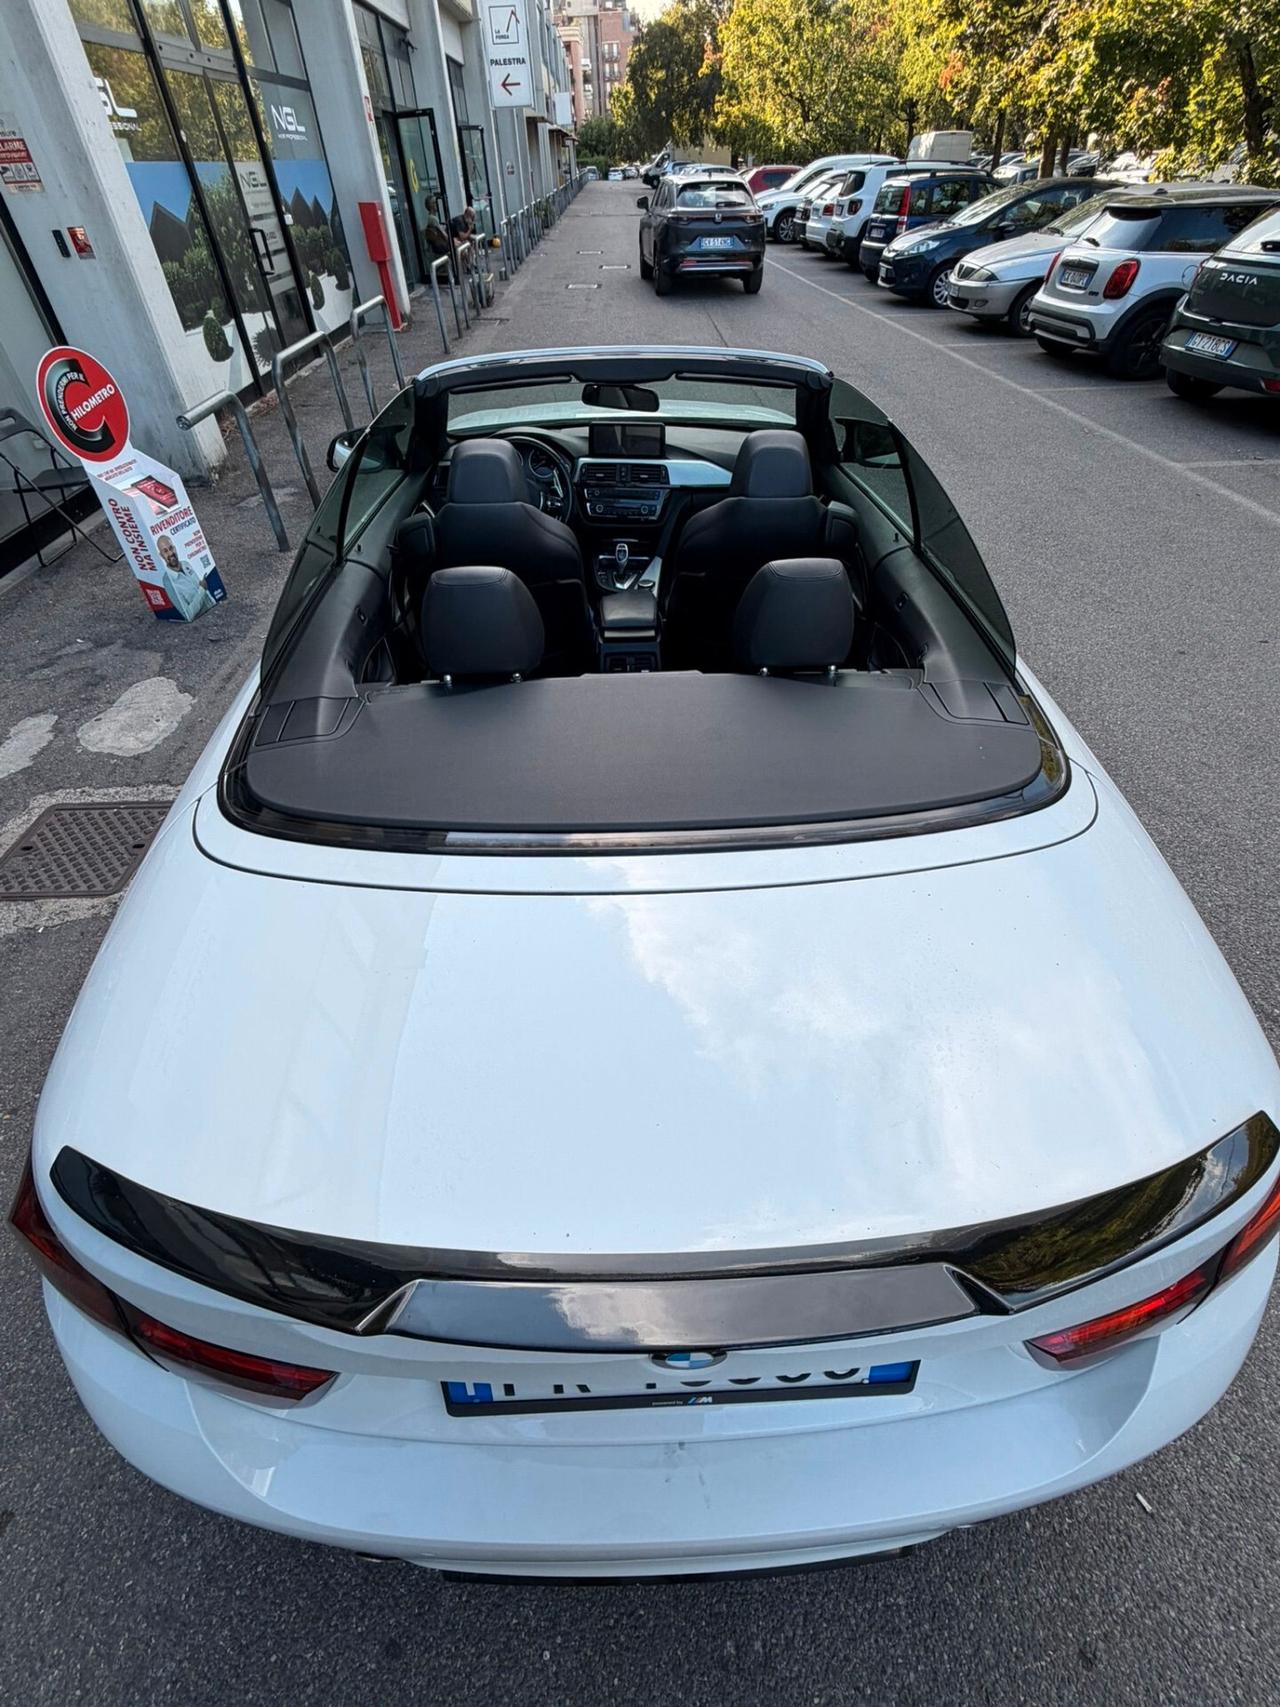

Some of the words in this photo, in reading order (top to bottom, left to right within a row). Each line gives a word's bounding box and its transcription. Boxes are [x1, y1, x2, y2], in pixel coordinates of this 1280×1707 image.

[490, 58, 526, 67] PALESTRA
[271, 104, 306, 133] NGL
[1220, 272, 1257, 286] DACIA
[67, 371, 78, 381] PER
[65, 414, 78, 431] NON
[108, 498, 136, 544] CONTRO
[120, 506, 149, 552] INSIEME
[150, 506, 194, 536] RIVENDITORE
[169, 516, 197, 536] CERTIFICATO
[132, 546, 149, 572] NON
[142, 554, 158, 573] MA
